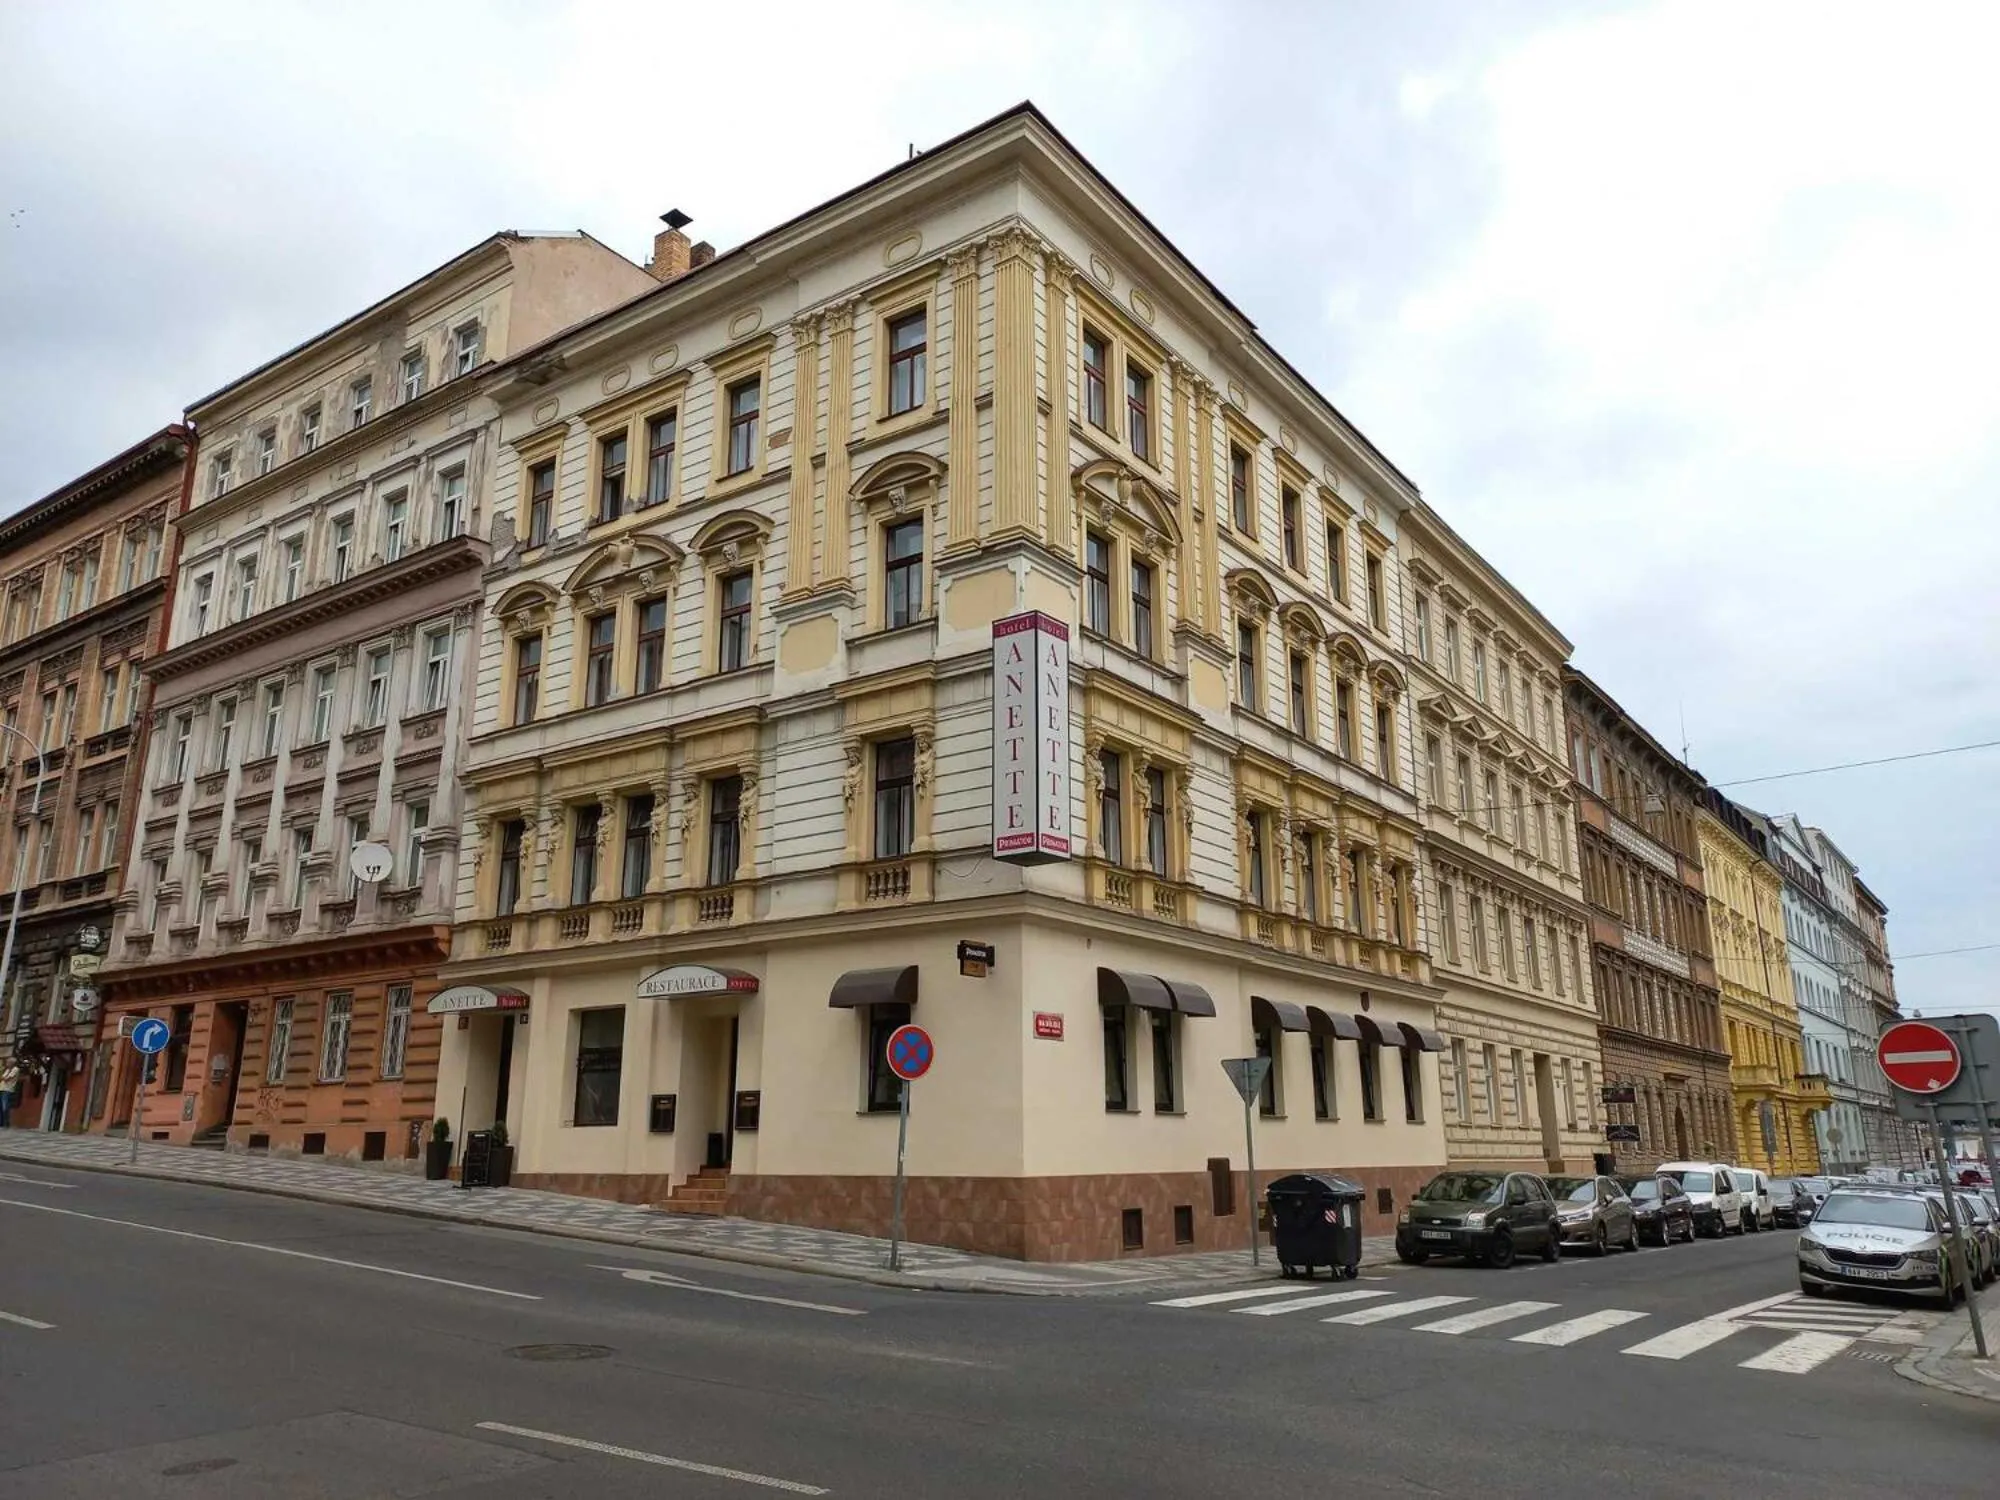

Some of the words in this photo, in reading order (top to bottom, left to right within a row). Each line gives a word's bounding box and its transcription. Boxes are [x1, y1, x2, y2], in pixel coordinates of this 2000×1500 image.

[1000, 618, 1030, 635] hotel
[1042, 619, 1064, 637] hotel
[1005, 641, 1025, 829] ANETTE
[1046, 643, 1061, 831] ANETTE
[645, 975, 719, 993] RESTAURACE
[442, 995, 487, 1009] ANETTE
[1826, 1231, 1905, 1245] POLICIE
